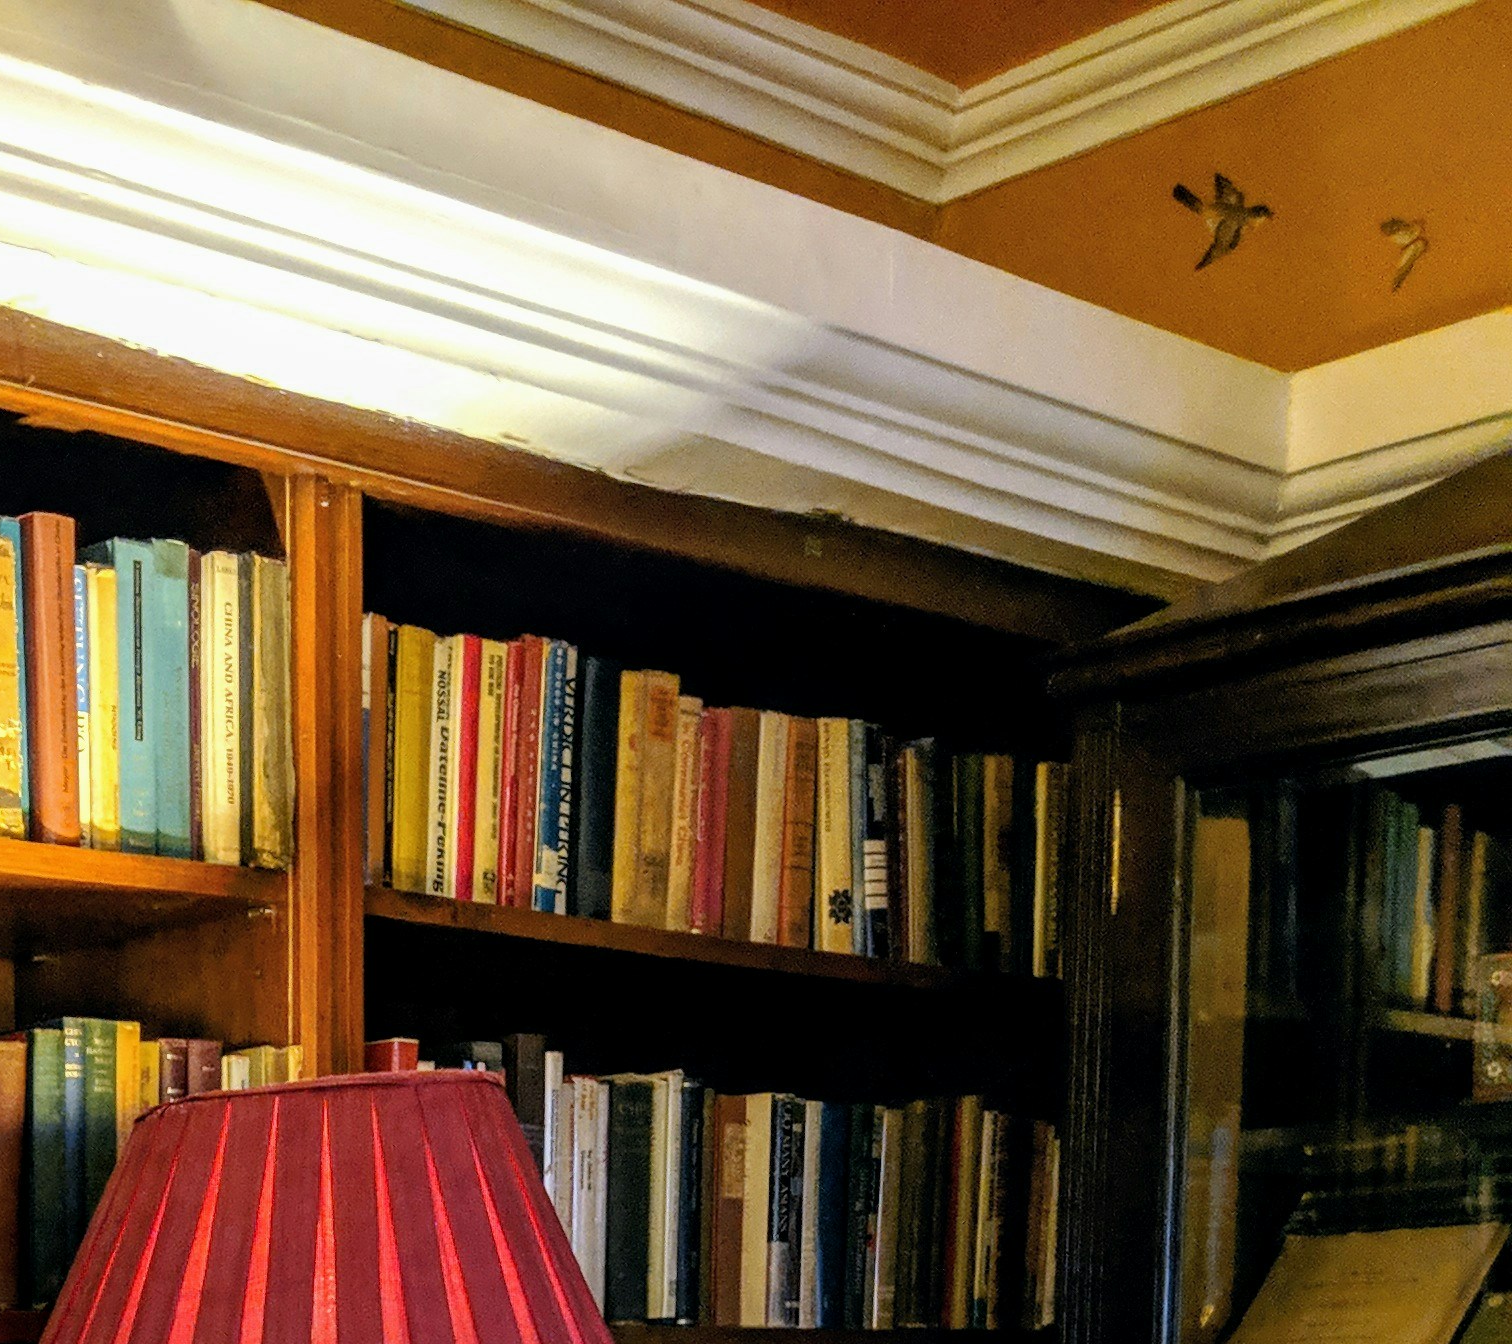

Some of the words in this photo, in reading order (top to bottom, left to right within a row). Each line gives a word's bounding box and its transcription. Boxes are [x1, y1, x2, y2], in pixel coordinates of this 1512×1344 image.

[223, 602, 233, 648] CHINA
[224, 653, 234, 683] AND
[225, 688, 235, 743] AFRICA,
[436, 668, 448, 723] NOSSAL
